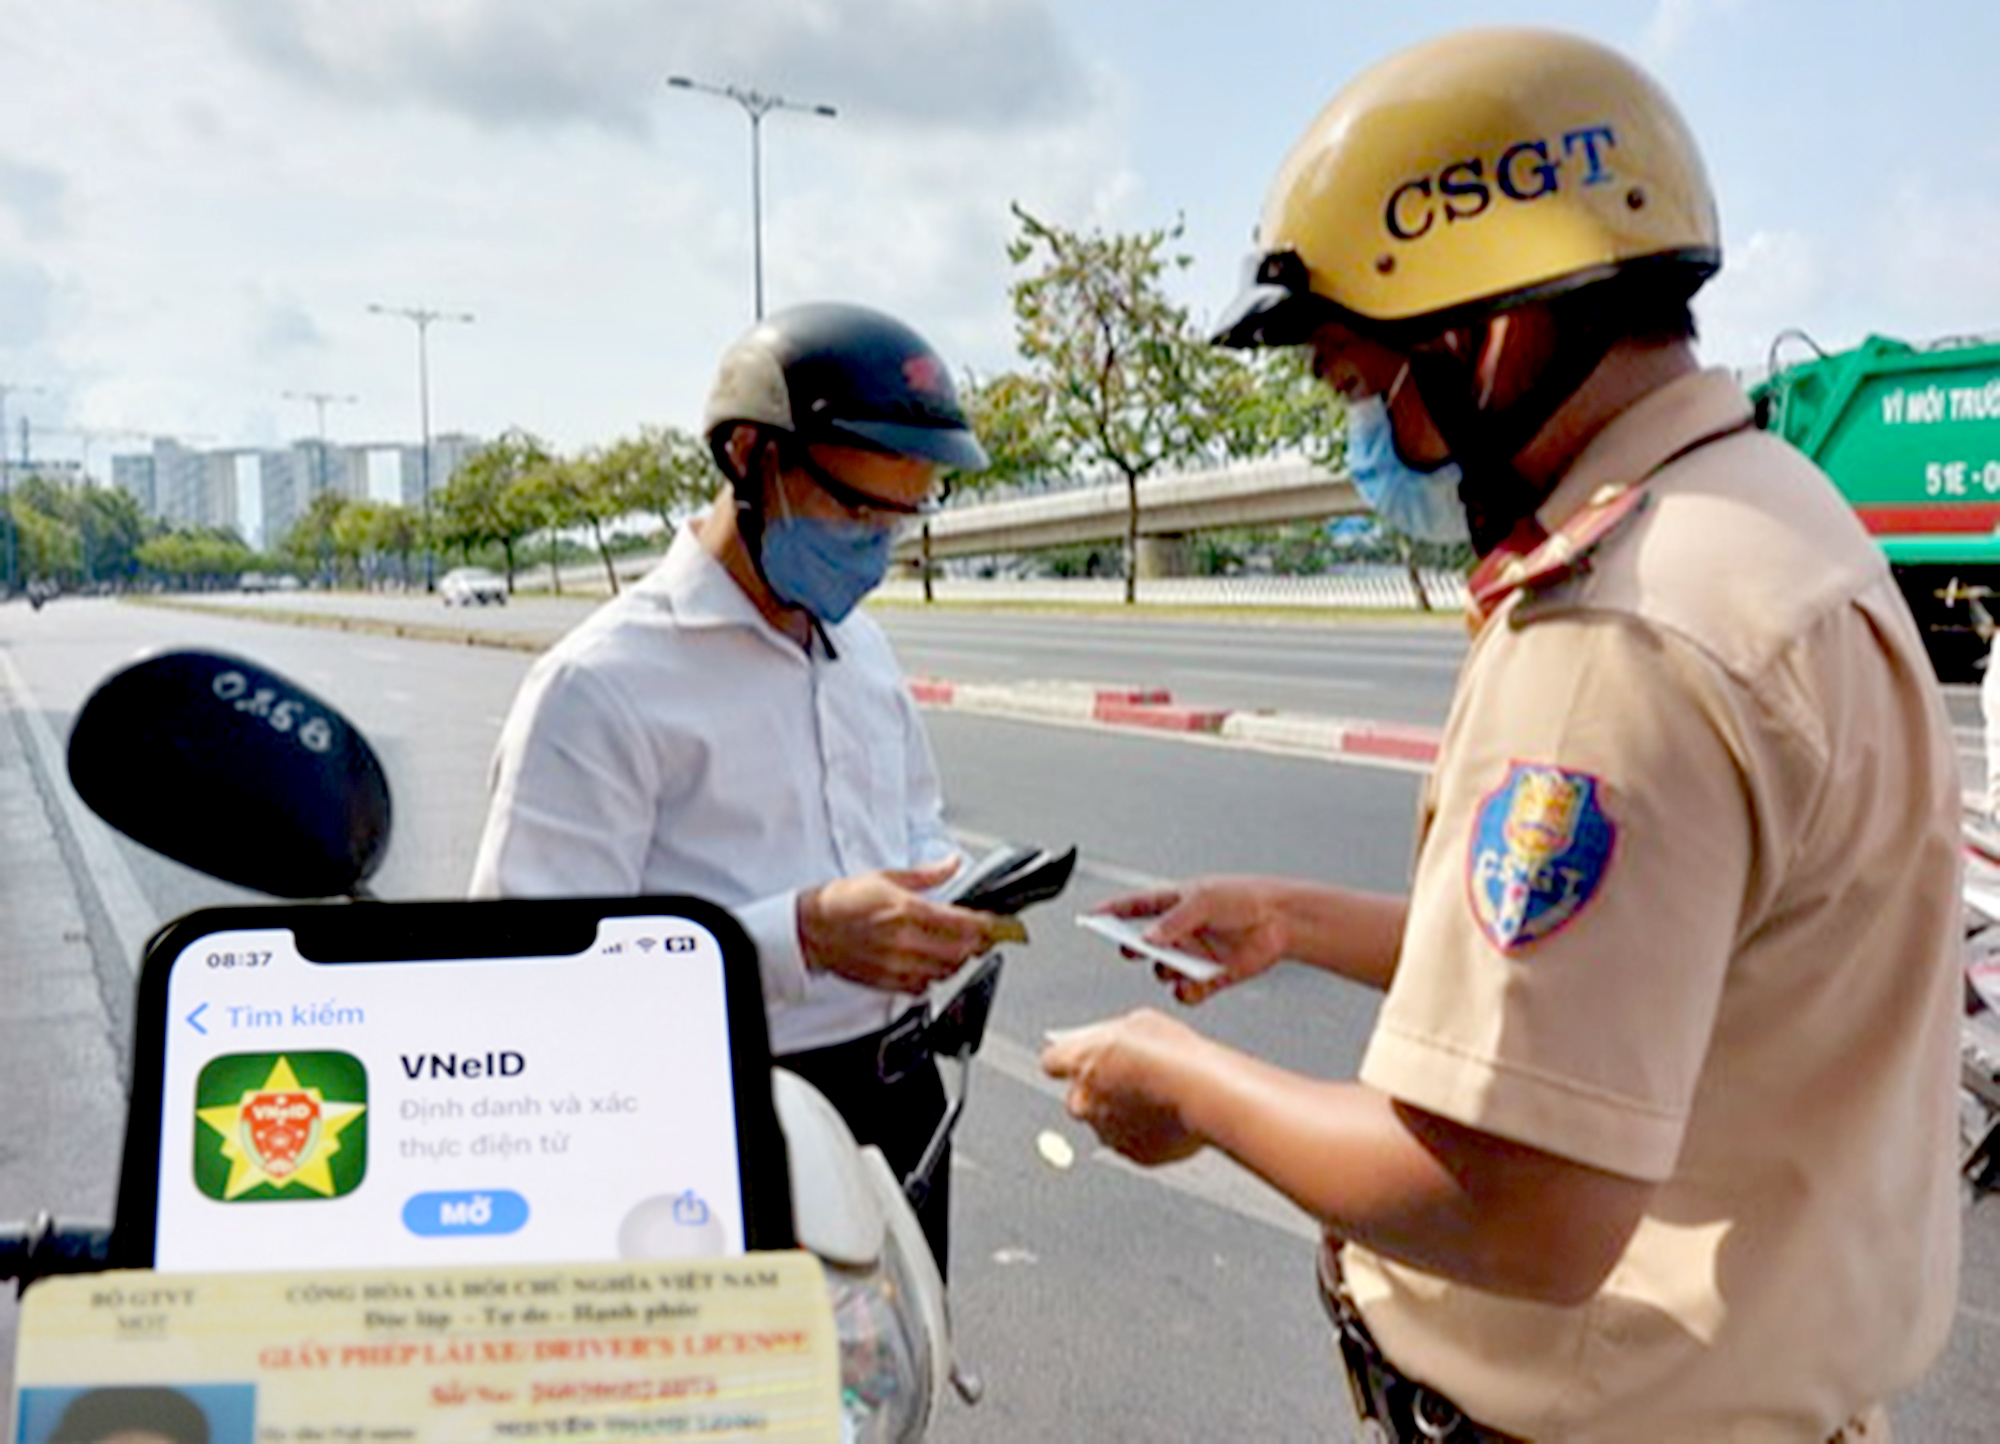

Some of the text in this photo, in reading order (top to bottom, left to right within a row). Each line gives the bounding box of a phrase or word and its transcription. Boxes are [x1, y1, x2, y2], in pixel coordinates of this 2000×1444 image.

[1385, 126, 1615, 240] CSGT
[206, 952, 272, 968] 08:37
[226, 998, 364, 1028] Tìm kiếm
[400, 1051, 526, 1079] VNeID
[400, 1091, 638, 1124] Định danh và xác
[400, 1137, 461, 1162] thực
[469, 1133, 532, 1160] điện
